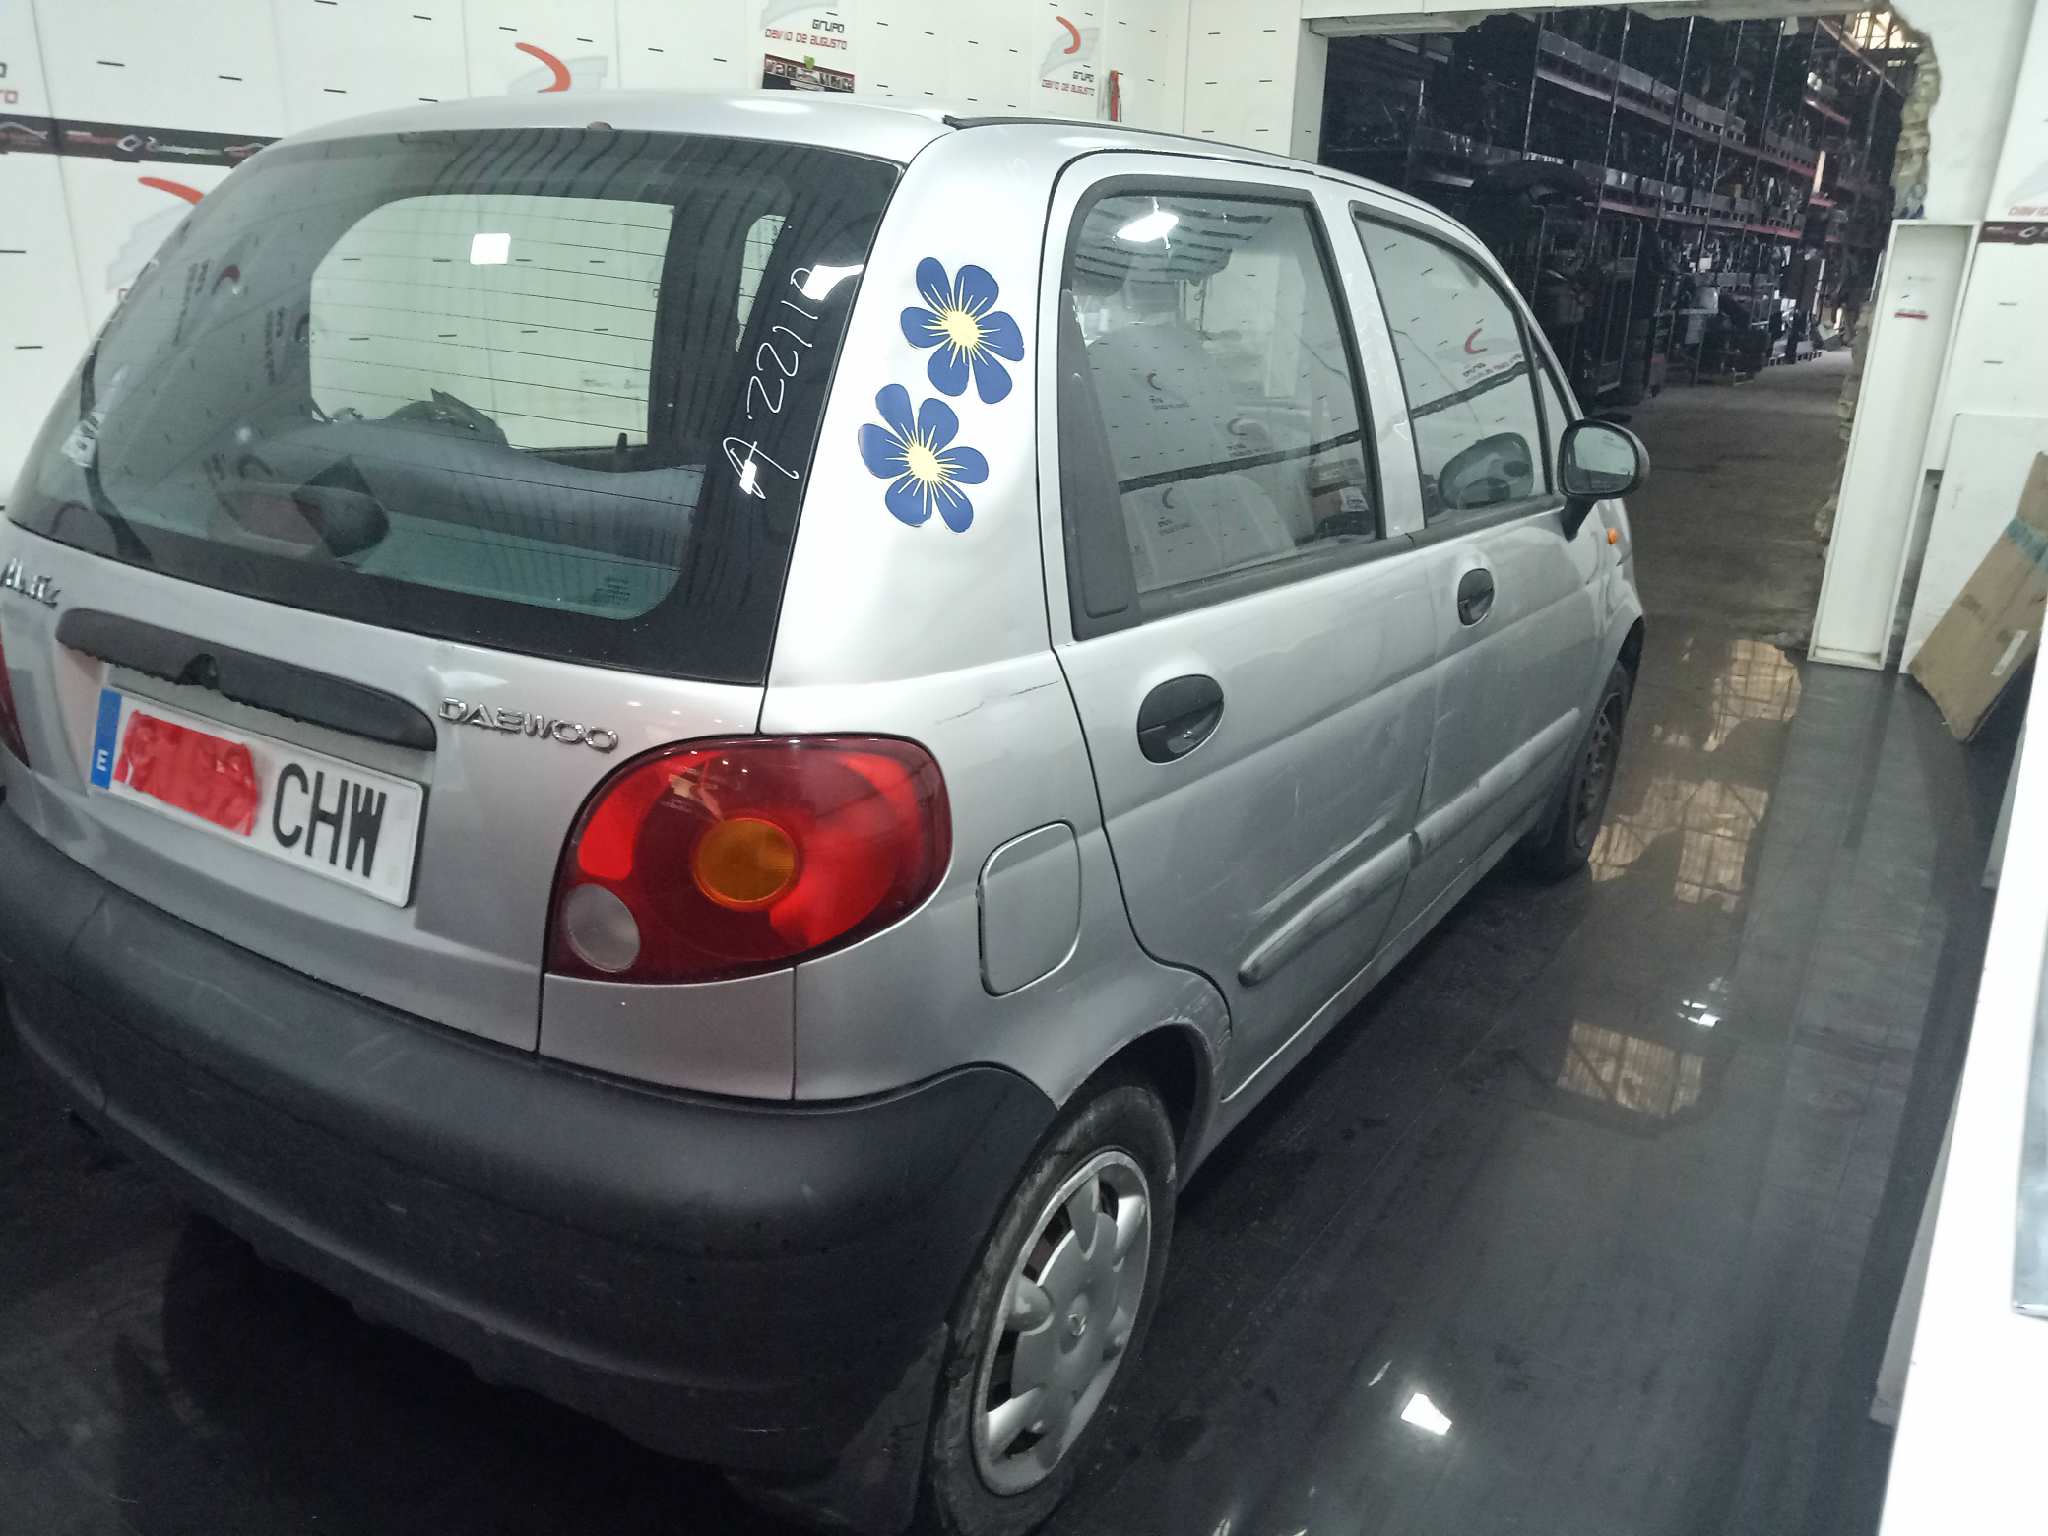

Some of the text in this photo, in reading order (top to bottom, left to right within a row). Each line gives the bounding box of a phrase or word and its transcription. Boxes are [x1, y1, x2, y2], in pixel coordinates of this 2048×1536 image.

[438, 697, 619, 754] DAEWOO
[95, 748, 109, 773] E
[272, 762, 388, 879] CHW
